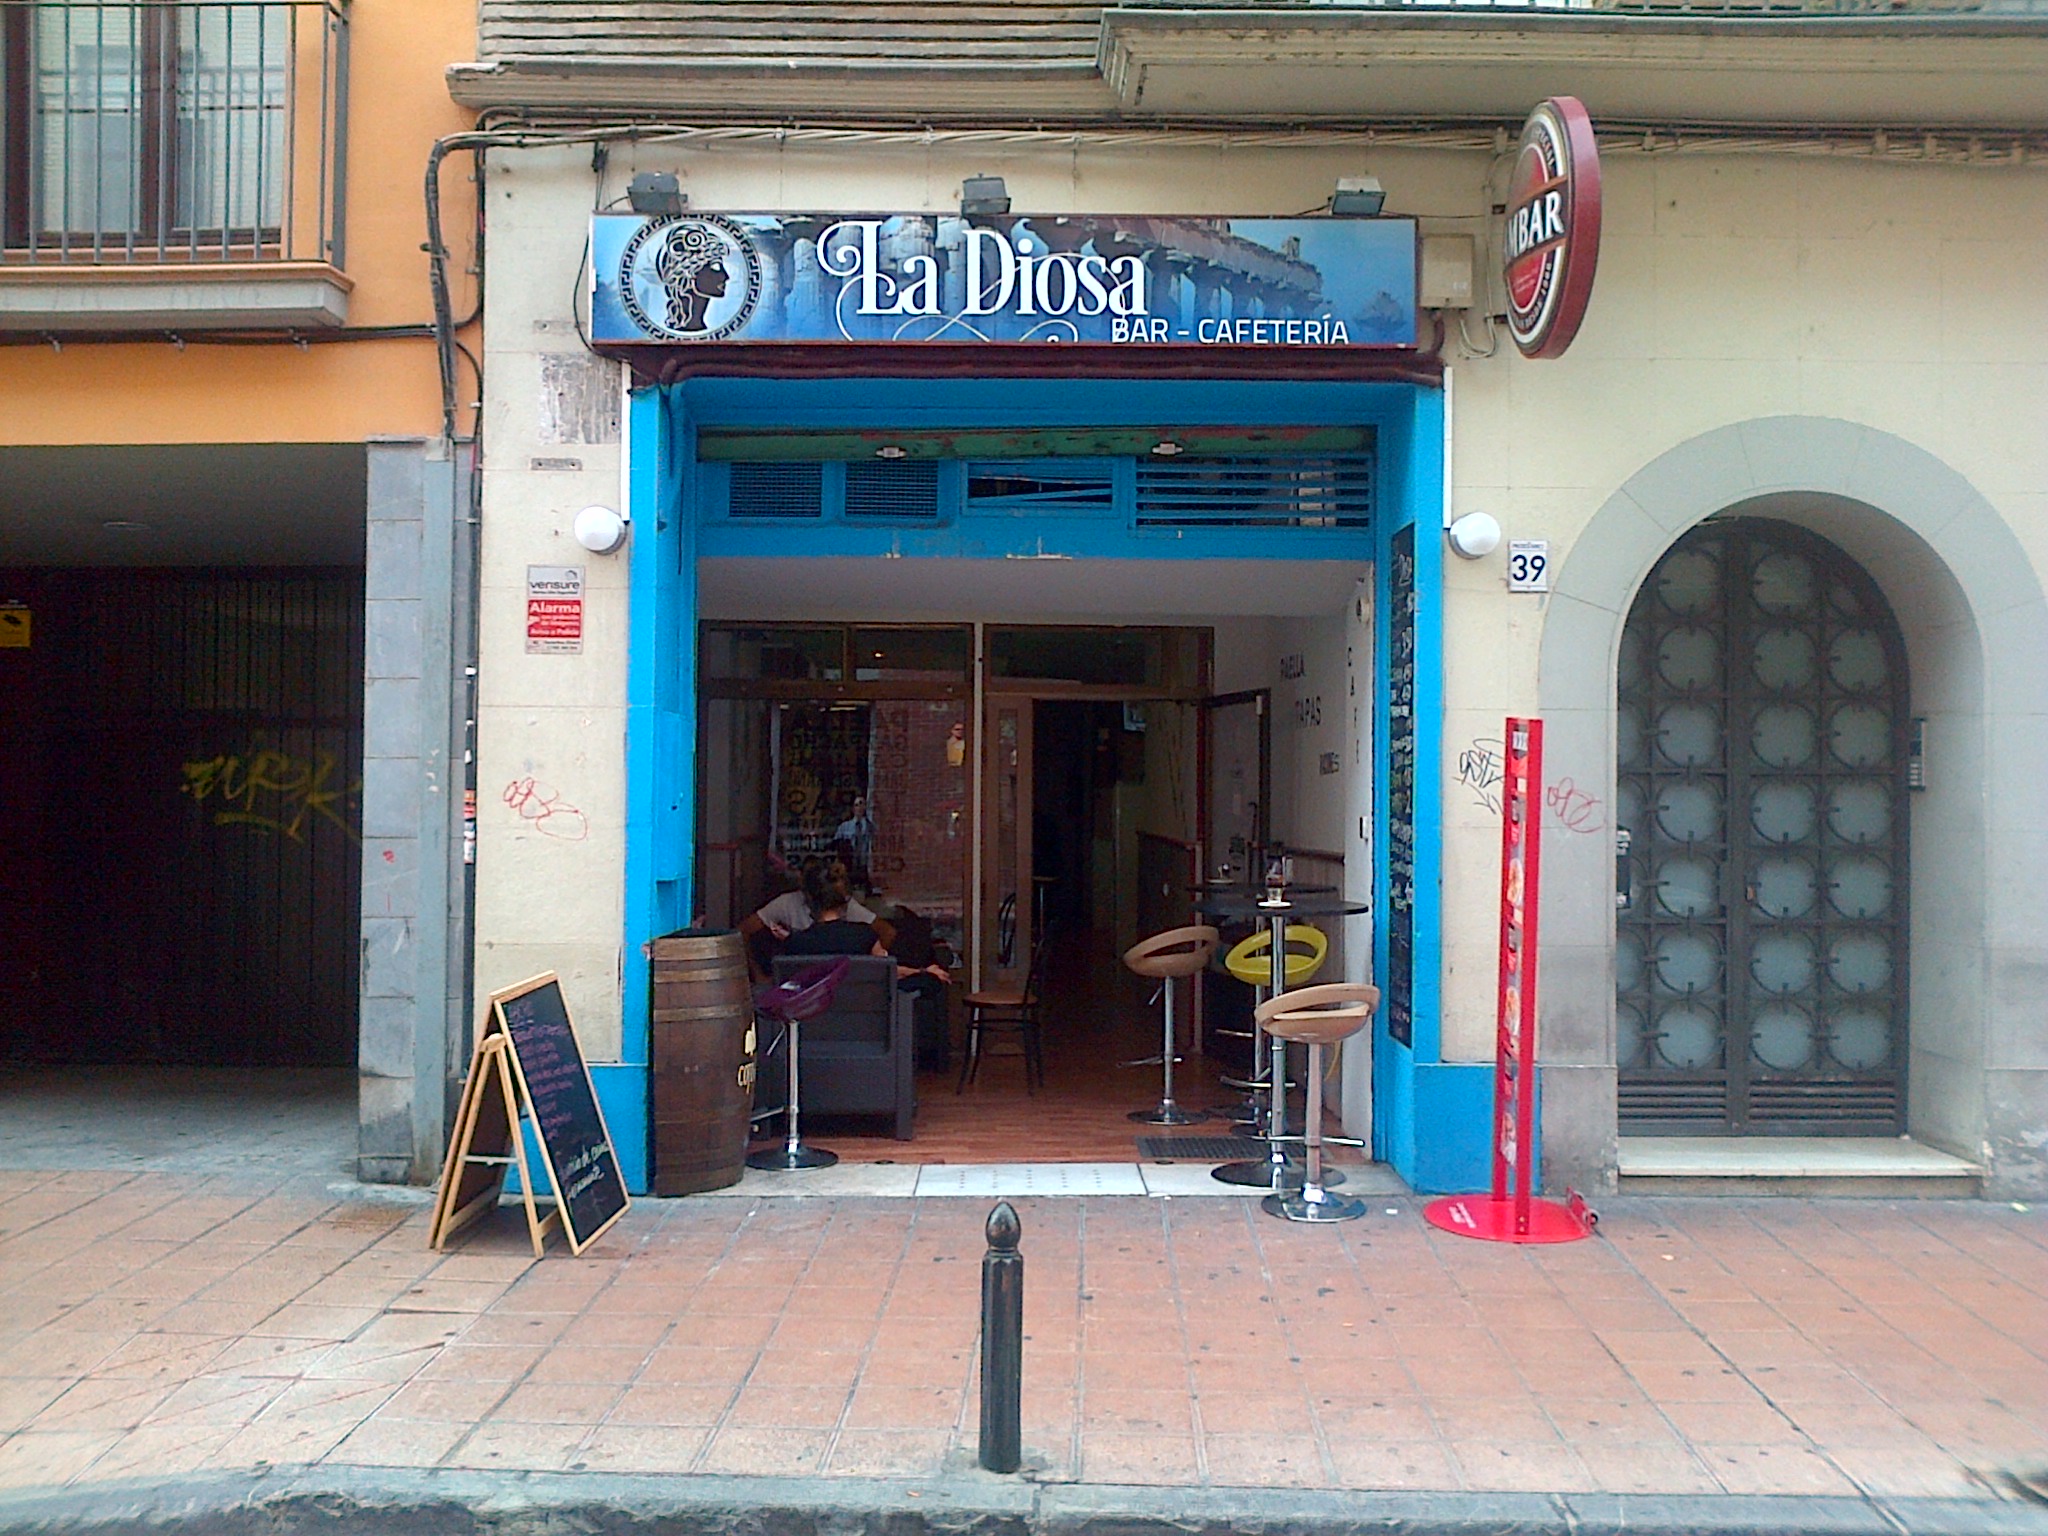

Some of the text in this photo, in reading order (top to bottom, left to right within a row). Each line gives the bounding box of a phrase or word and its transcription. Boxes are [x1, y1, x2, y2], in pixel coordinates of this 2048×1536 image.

[817, 220, 1148, 315] La Diosa
[1112, 318, 1169, 344] BAR
[1198, 313, 1350, 345] CAFETERÍA
[1512, 554, 1546, 582] 39
[530, 601, 580, 613] Alarma
[1296, 695, 1322, 729] TAPAS
